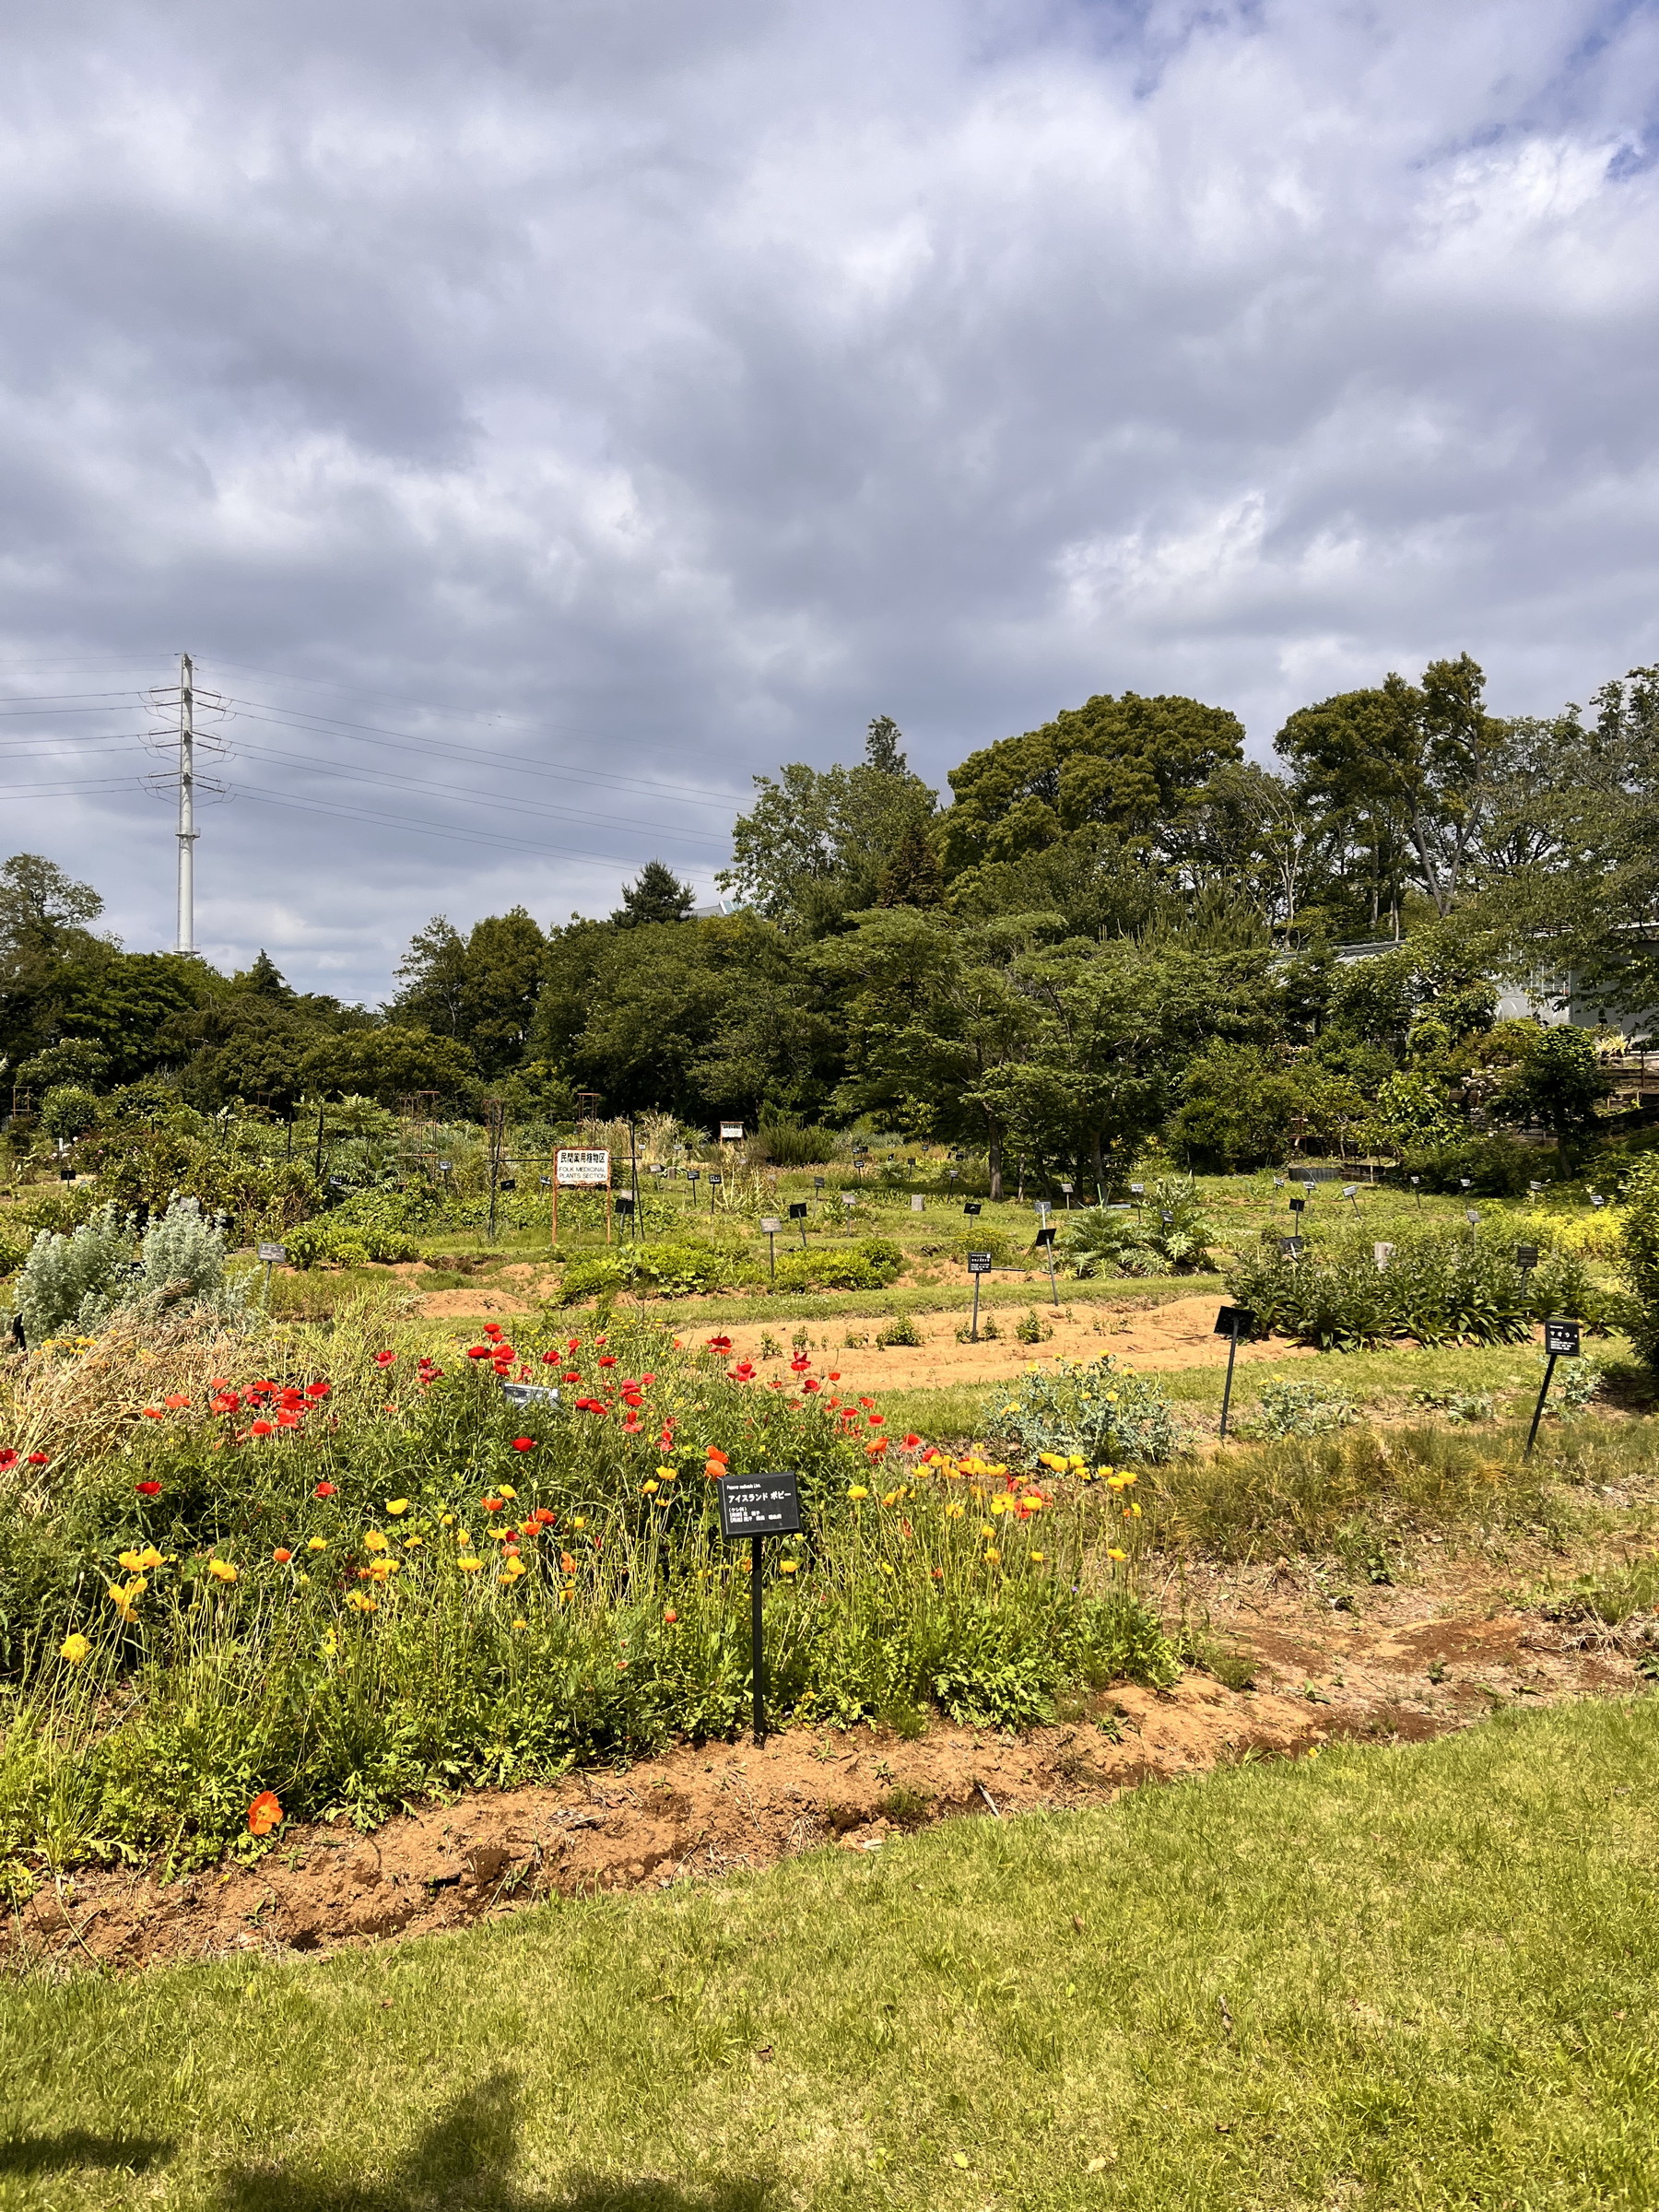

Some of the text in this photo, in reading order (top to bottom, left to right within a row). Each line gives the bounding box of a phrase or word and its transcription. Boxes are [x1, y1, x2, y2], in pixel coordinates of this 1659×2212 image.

[728, 1492, 769, 1503] アイスランド
